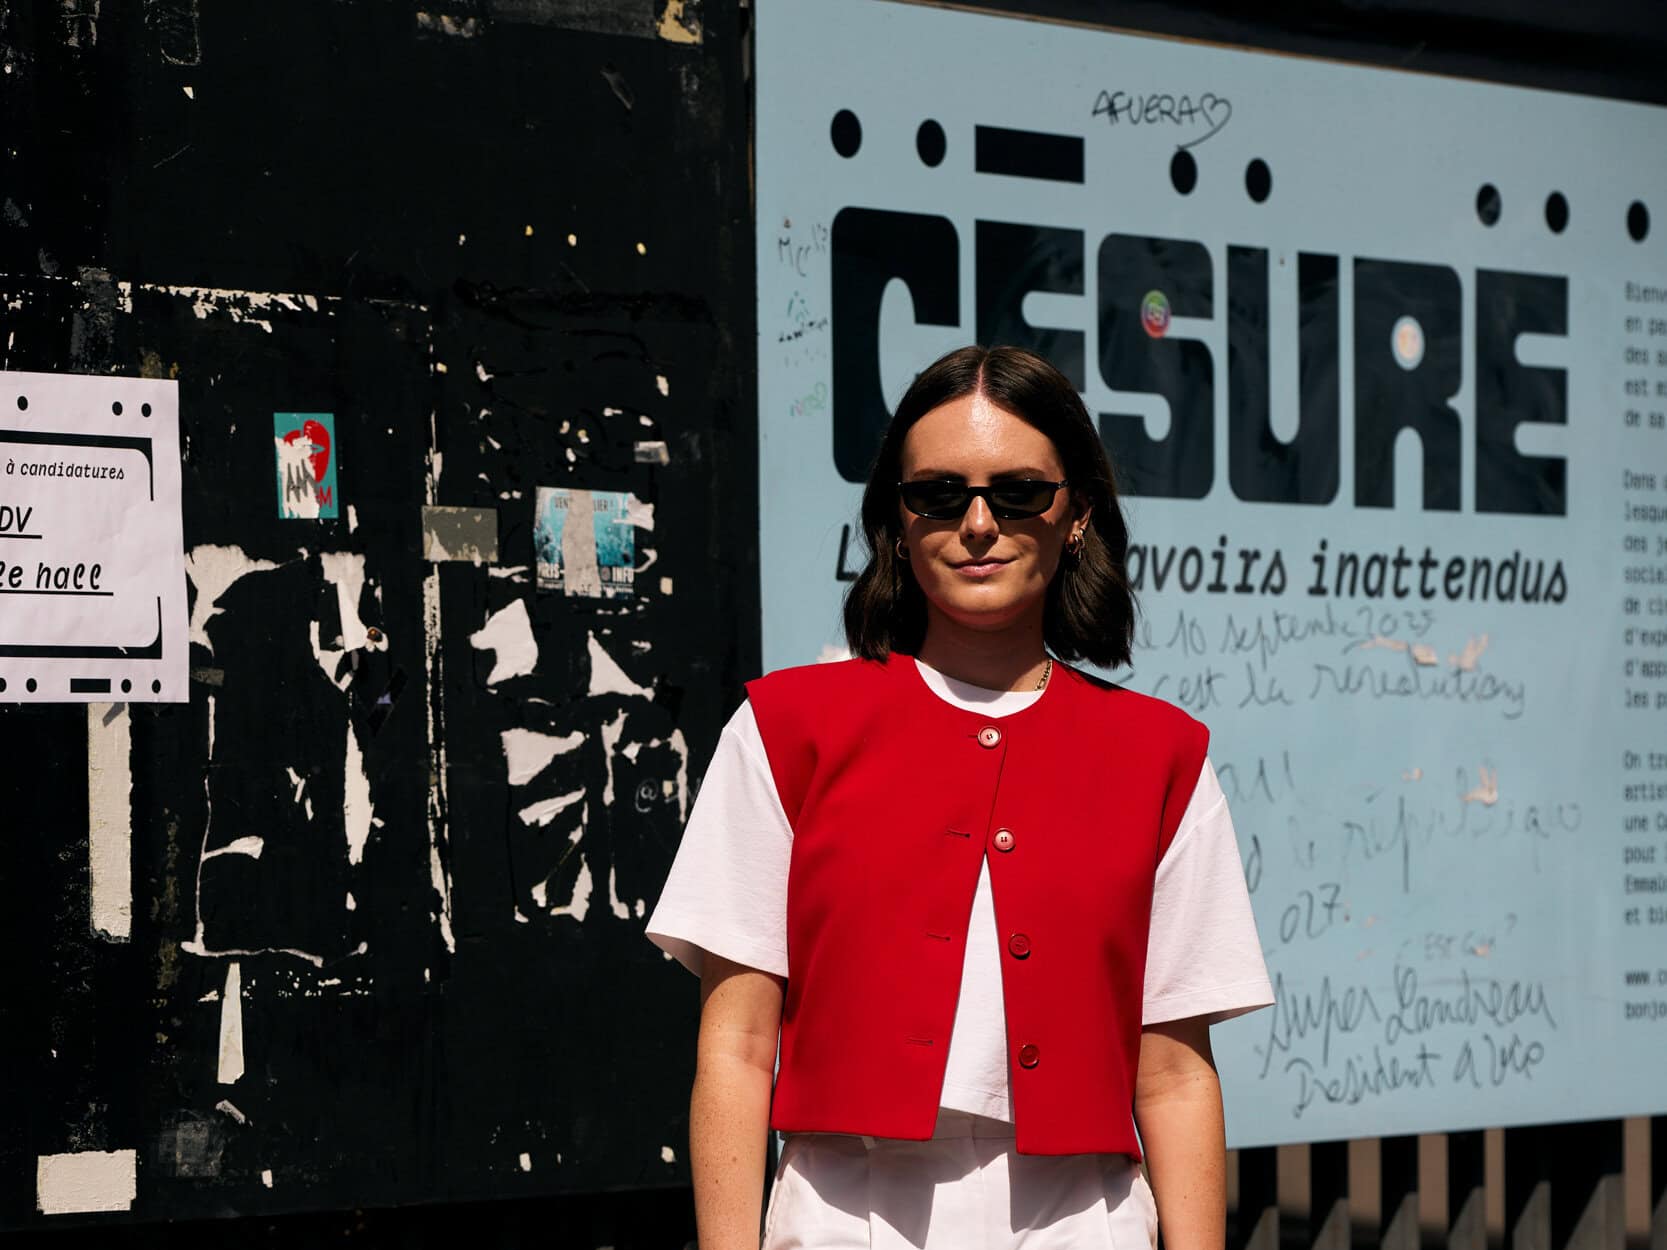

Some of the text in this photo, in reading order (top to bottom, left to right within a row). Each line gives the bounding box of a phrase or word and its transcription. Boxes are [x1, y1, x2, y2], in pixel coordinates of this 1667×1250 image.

[1625, 281, 1667, 303] Bienv
[6, 458, 125, 480] à candidatures
[1624, 501, 1667, 523] lesqu
[36, 562, 101, 590] hall
[1126, 535, 1568, 604] avoirs inattendus
[1624, 1000, 1667, 1022] bonjo
